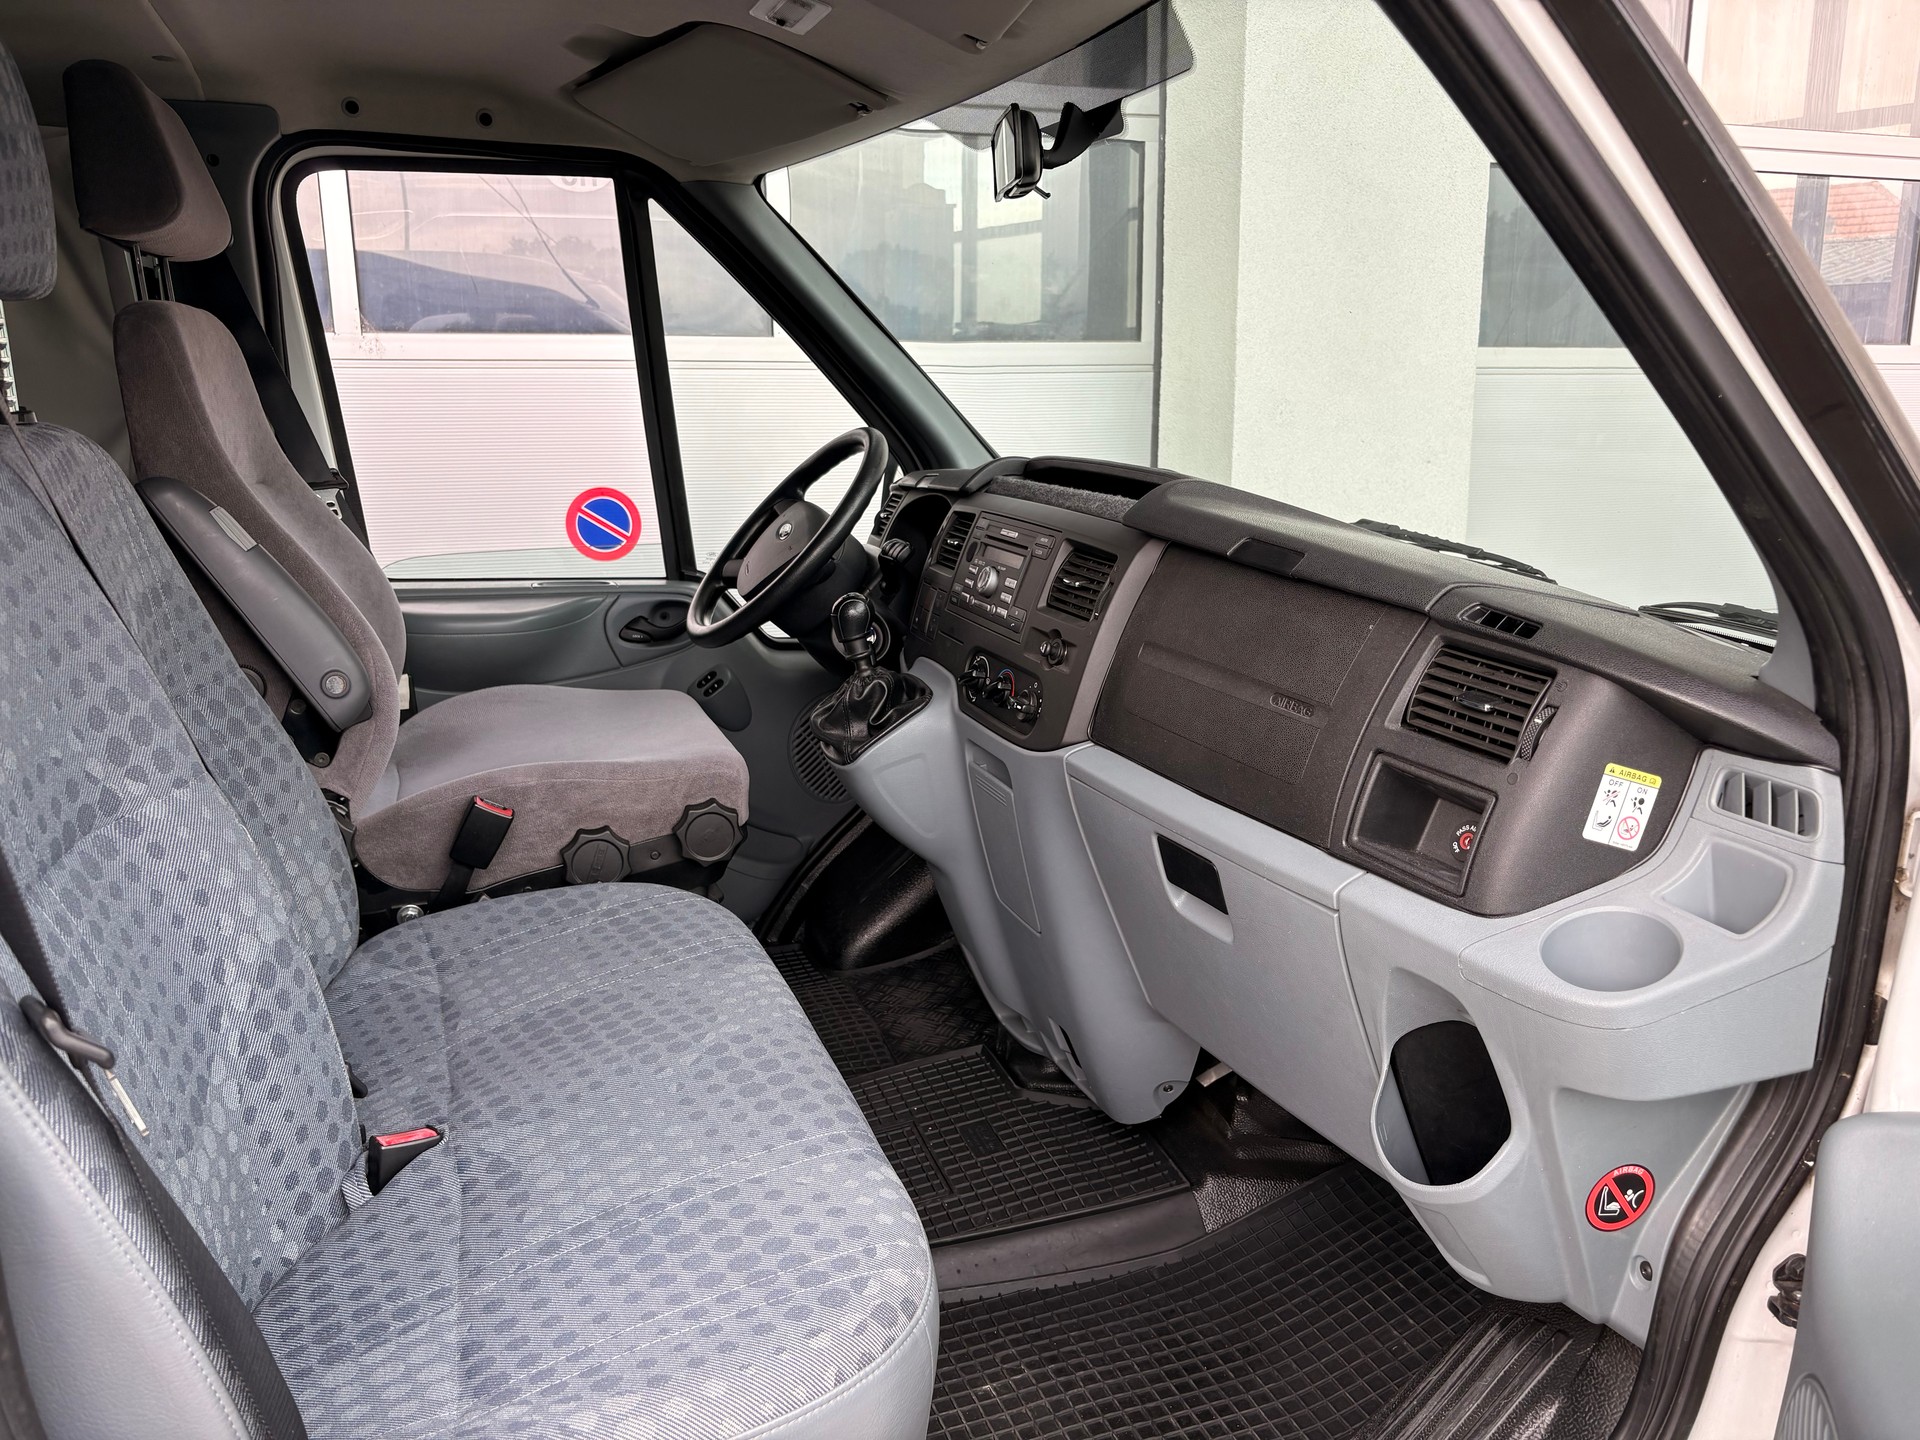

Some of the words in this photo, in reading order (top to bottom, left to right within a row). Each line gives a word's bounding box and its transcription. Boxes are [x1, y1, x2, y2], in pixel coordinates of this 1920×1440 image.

[1273, 697, 1313, 716] AIRBAG
[1619, 769, 1648, 783] AIRBAG
[1608, 779, 1624, 788] OFF
[1636, 787, 1648, 795] ON
[1613, 1166, 1644, 1176] AIRBAG
